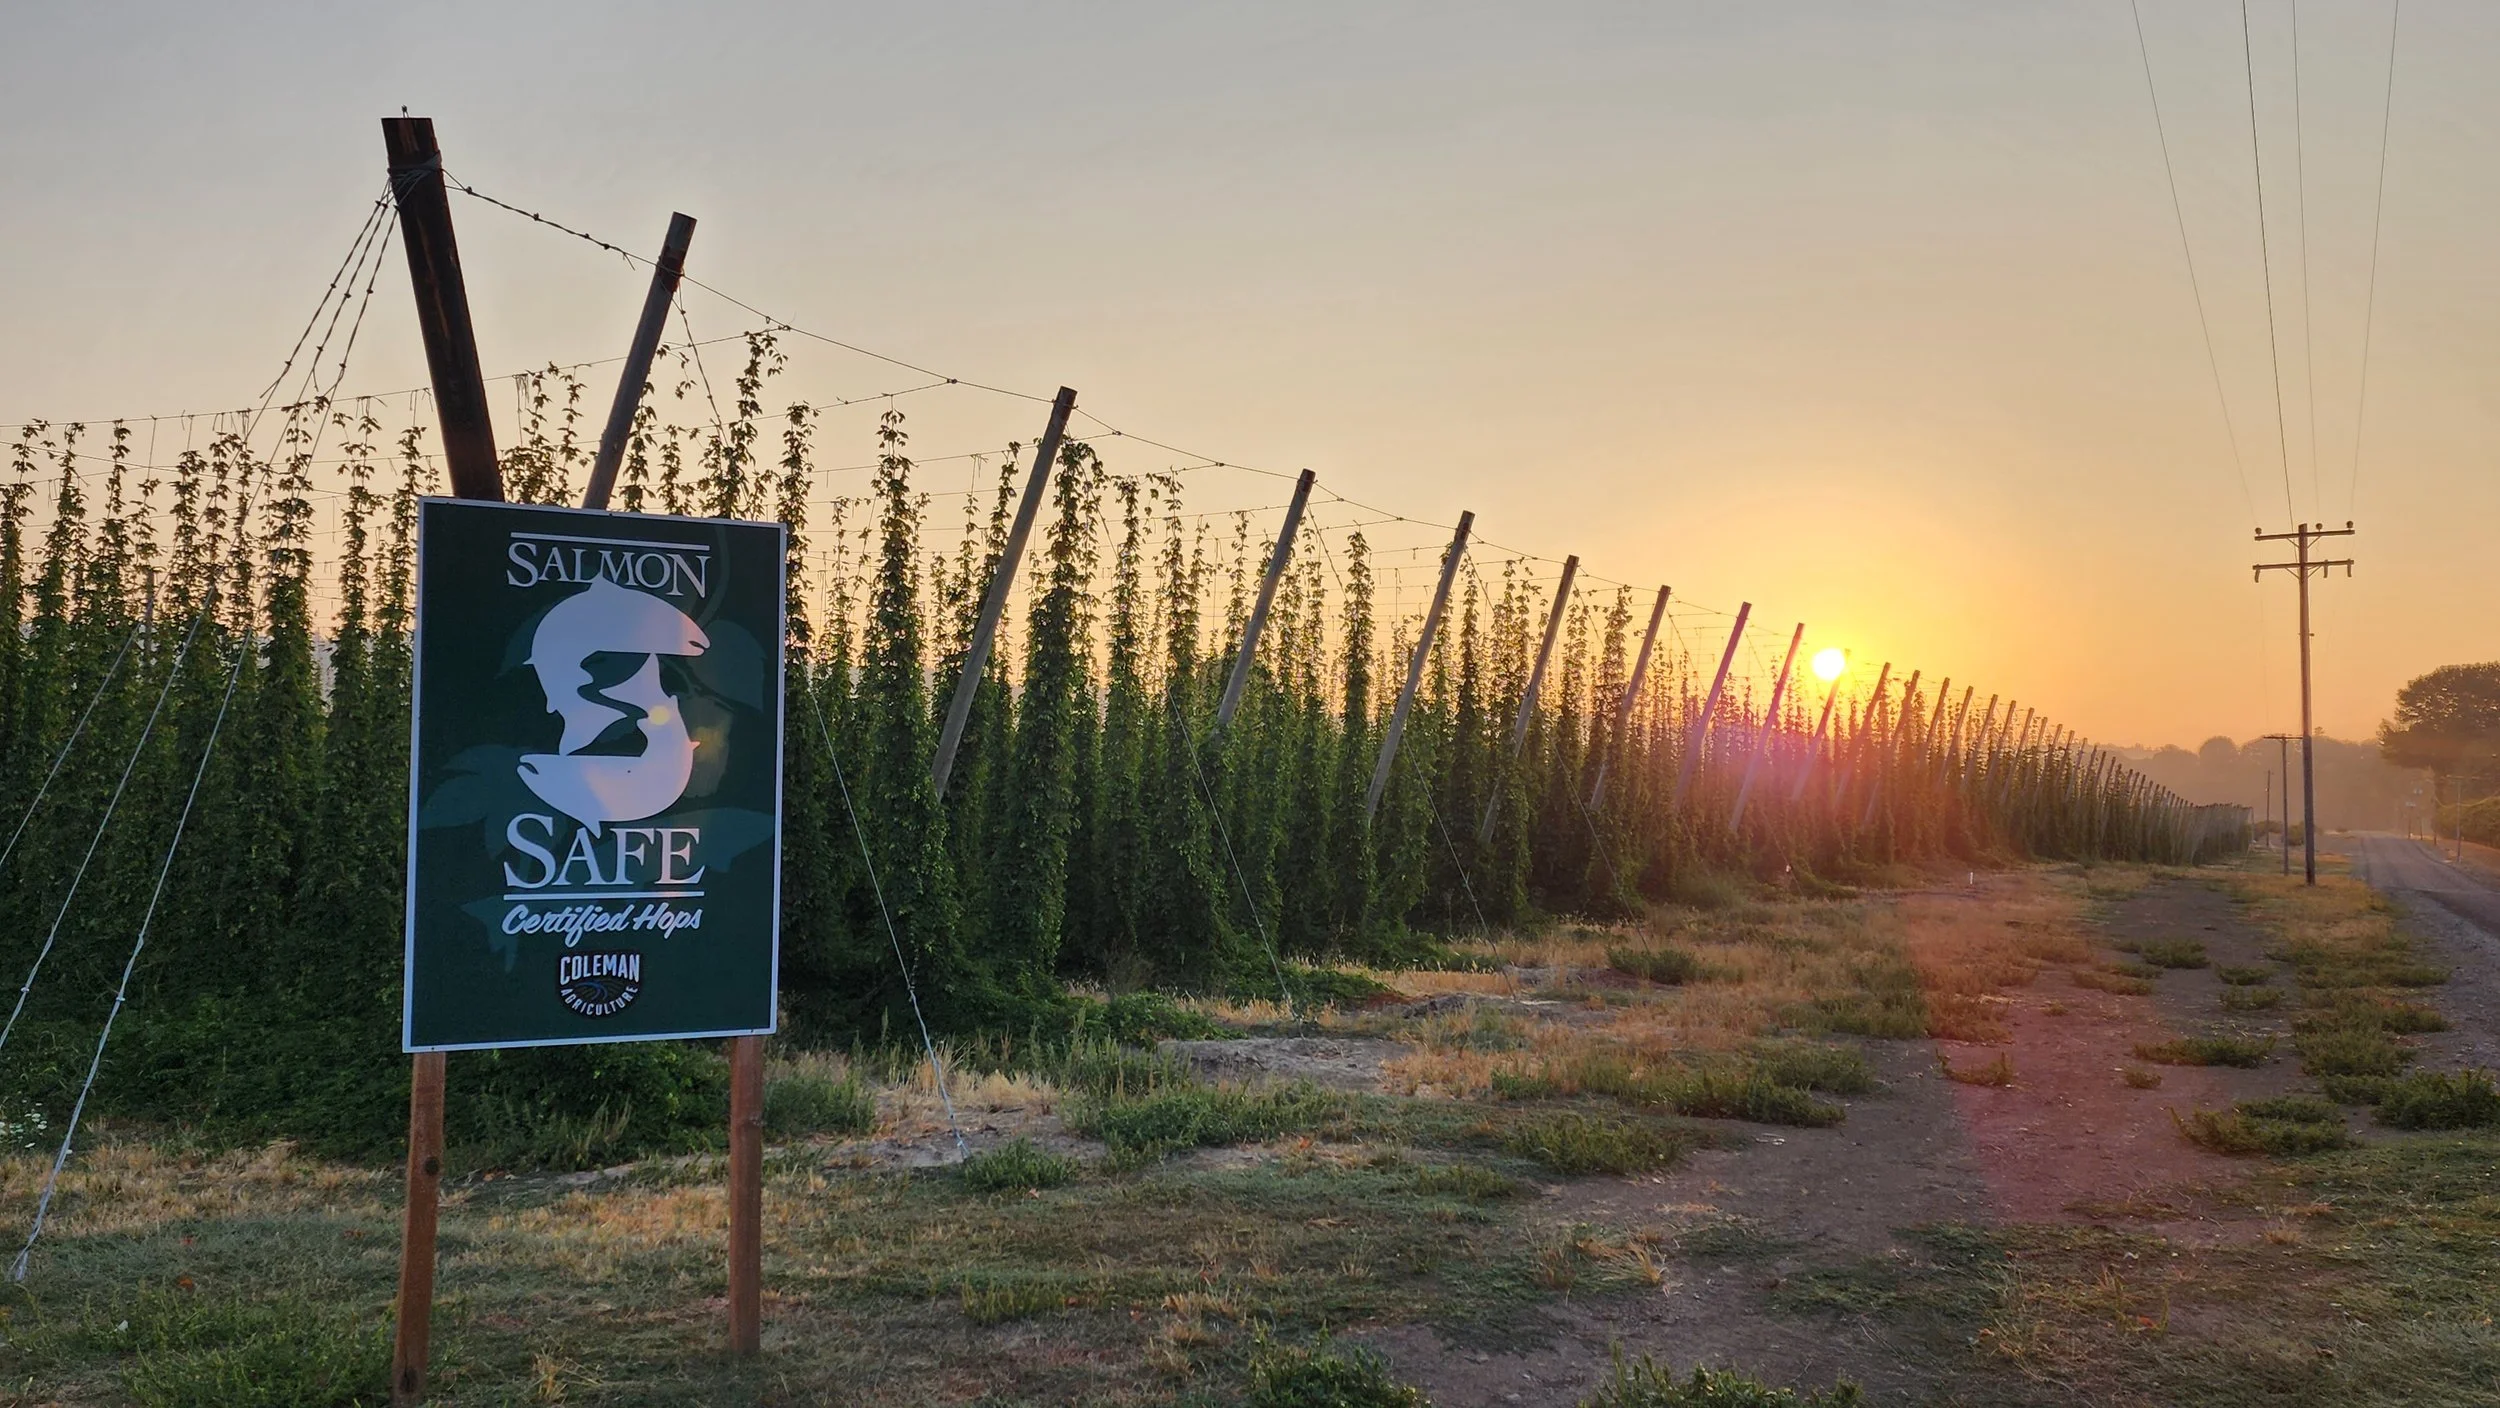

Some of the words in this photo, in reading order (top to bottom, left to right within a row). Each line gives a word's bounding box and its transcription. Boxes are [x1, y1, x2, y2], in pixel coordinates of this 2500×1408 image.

[506, 542, 711, 598] SALMON
[503, 813, 706, 889] SAFE
[502, 904, 635, 948] Certified
[632, 902, 703, 939] Hops
[559, 954, 640, 985] COLEMAN
[560, 986, 639, 1016] AGRICULTURE
